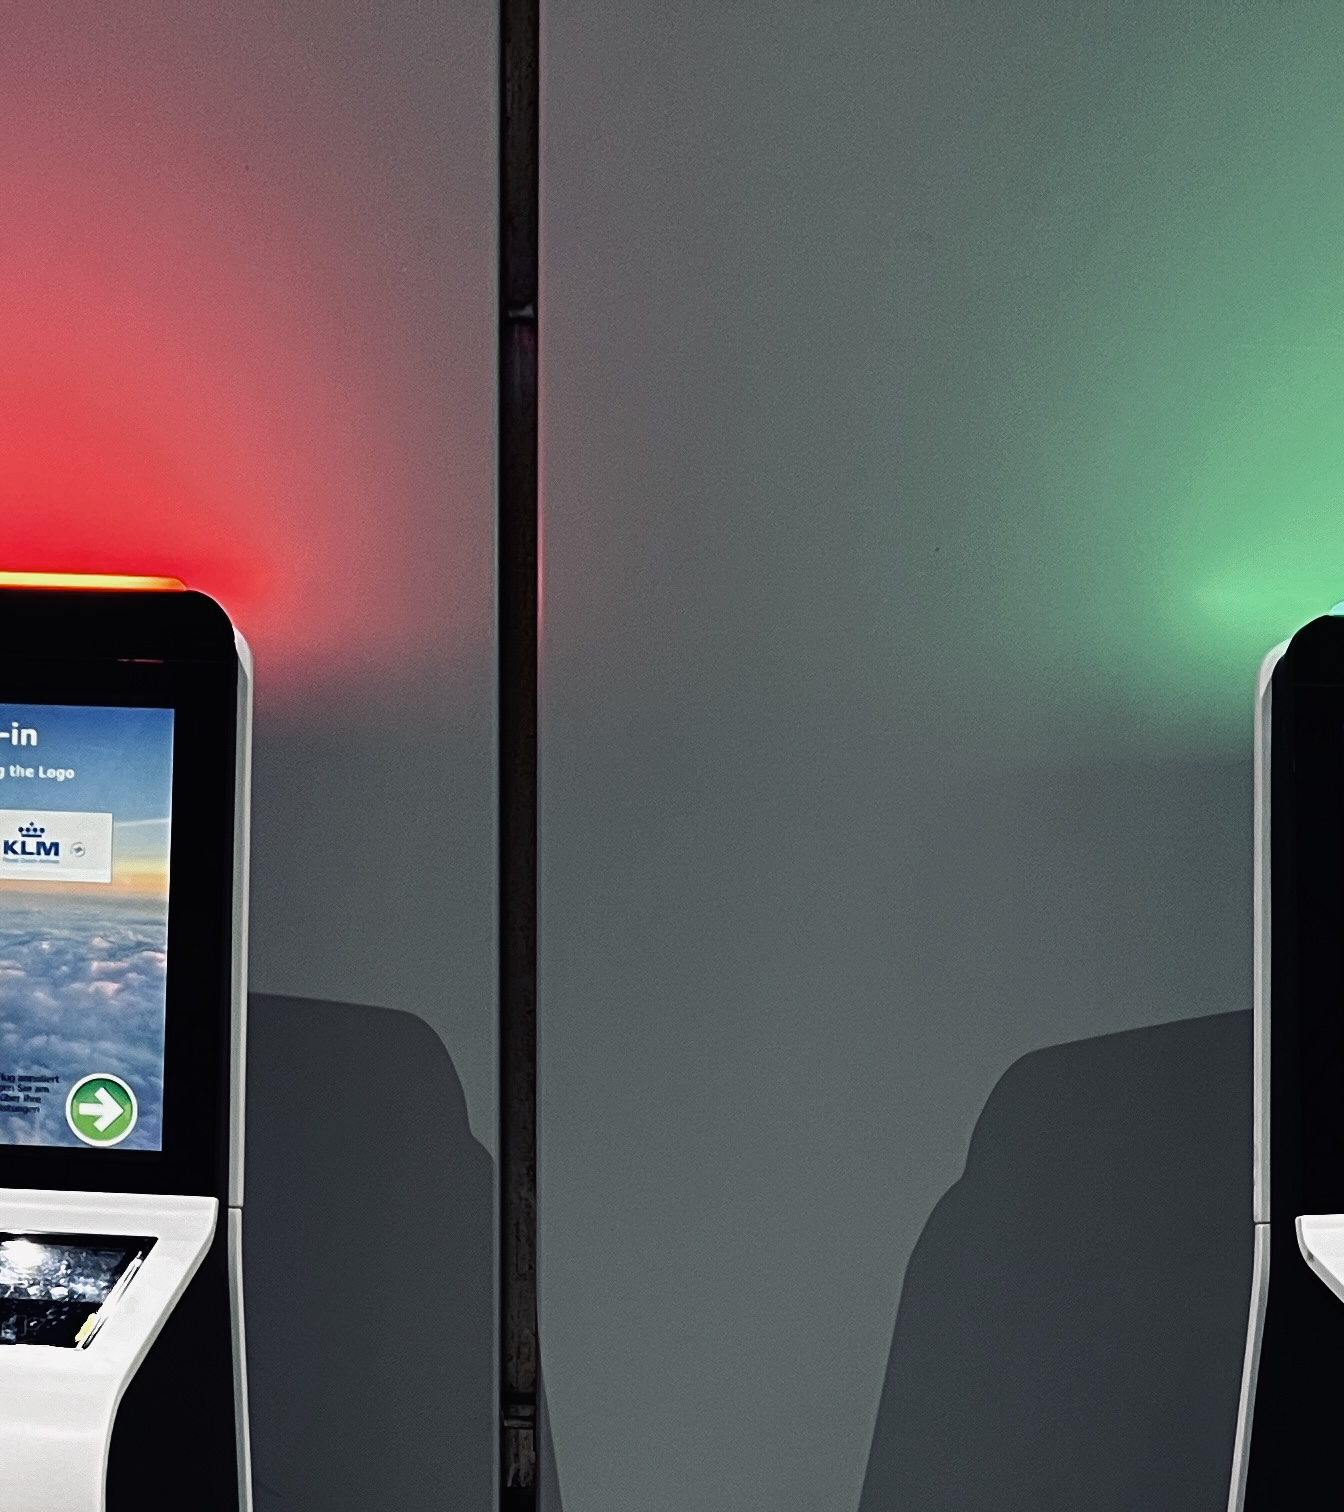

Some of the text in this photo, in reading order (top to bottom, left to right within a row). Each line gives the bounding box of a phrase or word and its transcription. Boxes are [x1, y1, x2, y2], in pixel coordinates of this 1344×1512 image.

[10, 764, 34, 778] the
[39, 766, 74, 781] Logo
[3, 839, 60, 857] KLM
